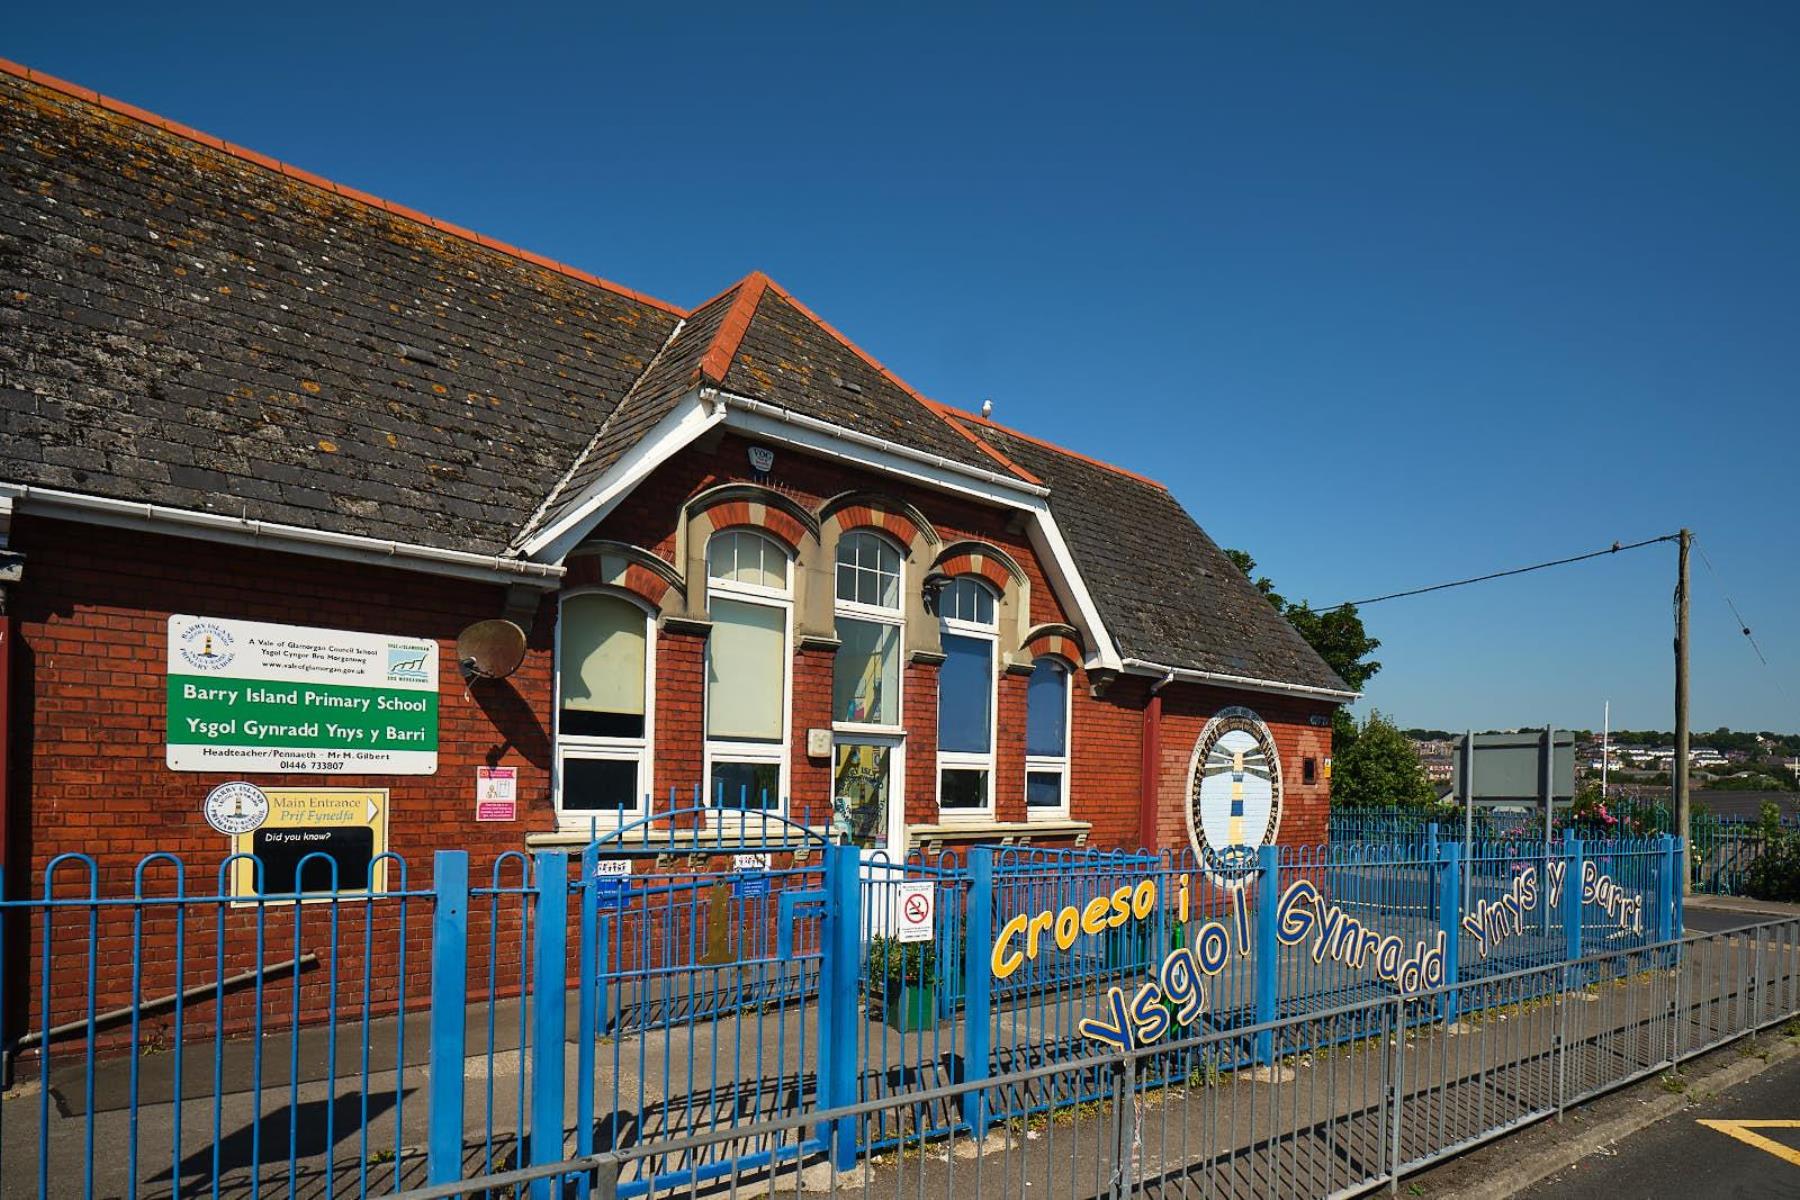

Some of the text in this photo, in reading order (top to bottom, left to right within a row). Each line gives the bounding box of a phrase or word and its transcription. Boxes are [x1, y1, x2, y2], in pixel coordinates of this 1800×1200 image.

[258, 639, 274, 647] Vale
[287, 641, 326, 652] Glamorgan
[328, 645, 354, 653] Council
[356, 648, 378, 656] School
[261, 648, 367, 664] Ysgol Cyngor Bro Morgannwg
[261, 661, 365, 675] www.valeofglamorgan.gov.uk
[183, 683, 427, 713] Barry Island Primary School
[186, 717, 425, 743] Ysgol Gynradd Ynys y Barri
[202, 748, 316, 759] Headteacher/Pennaeth
[327, 751, 341, 759] Mr
[356, 752, 390, 760] Gilbert
[280, 760, 344, 770] 01446 733807
[273, 797, 361, 808] Main Entrance
[280, 810, 354, 824] Prif Fynedfa
[265, 832, 332, 843] Did you know?
[991, 873, 1190, 979] Croeso i
[1079, 884, 1251, 1056] Ysgol
[1276, 879, 1447, 1001] Gynradd
[1463, 867, 1537, 959] Ynys
[1581, 860, 1642, 937] Barri
